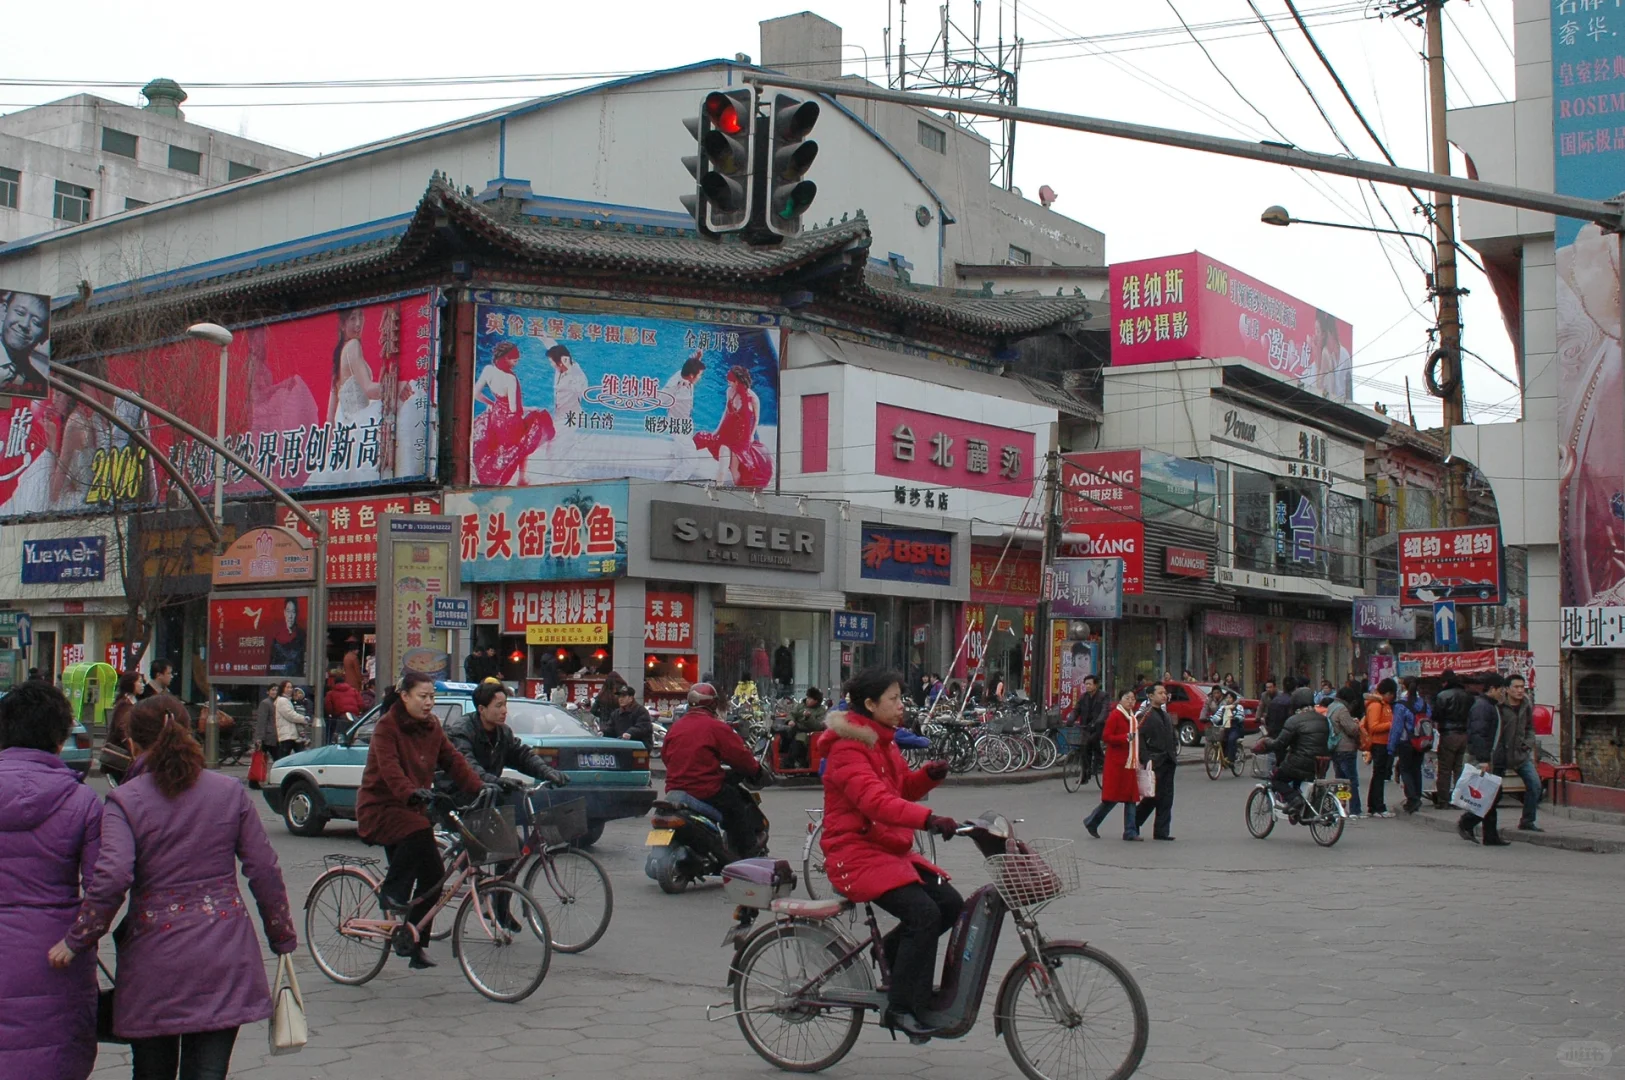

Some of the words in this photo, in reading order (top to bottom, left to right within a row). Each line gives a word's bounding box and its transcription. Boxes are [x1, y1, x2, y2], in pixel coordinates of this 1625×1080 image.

[1559, 55, 1625, 87] 皇室经典
[1560, 125, 1625, 157] 国际极品
[1122, 269, 1184, 310] 维纳斯
[1206, 264, 1228, 296] 2006
[485, 313, 658, 345] 英伦圣堡豪华摄影区
[684, 329, 740, 353] 全新开幕
[1119, 312, 1188, 346] 婚纱摄影
[602, 374, 660, 398] 维纳斯
[564, 410, 615, 431] 来自台湾
[644, 416, 694, 435] 婚纱摄影
[1224, 410, 1256, 442] Venus
[1070, 466, 1134, 486] AOKANG
[894, 485, 949, 511] 婚纱名店
[1079, 488, 1123, 502] 奥康皮鞋
[1069, 533, 1134, 554] AOKANG
[588, 559, 616, 573] 二部
[1408, 572, 1432, 587] DO
[437, 601, 454, 610] TAXI
[512, 589, 612, 625] 开口笑糖炒栗子
[652, 600, 683, 618] 天津
[407, 600, 422, 647] 小米粥
[644, 622, 690, 642] 大糖葫芦
[839, 615, 869, 629] 钟楼街
